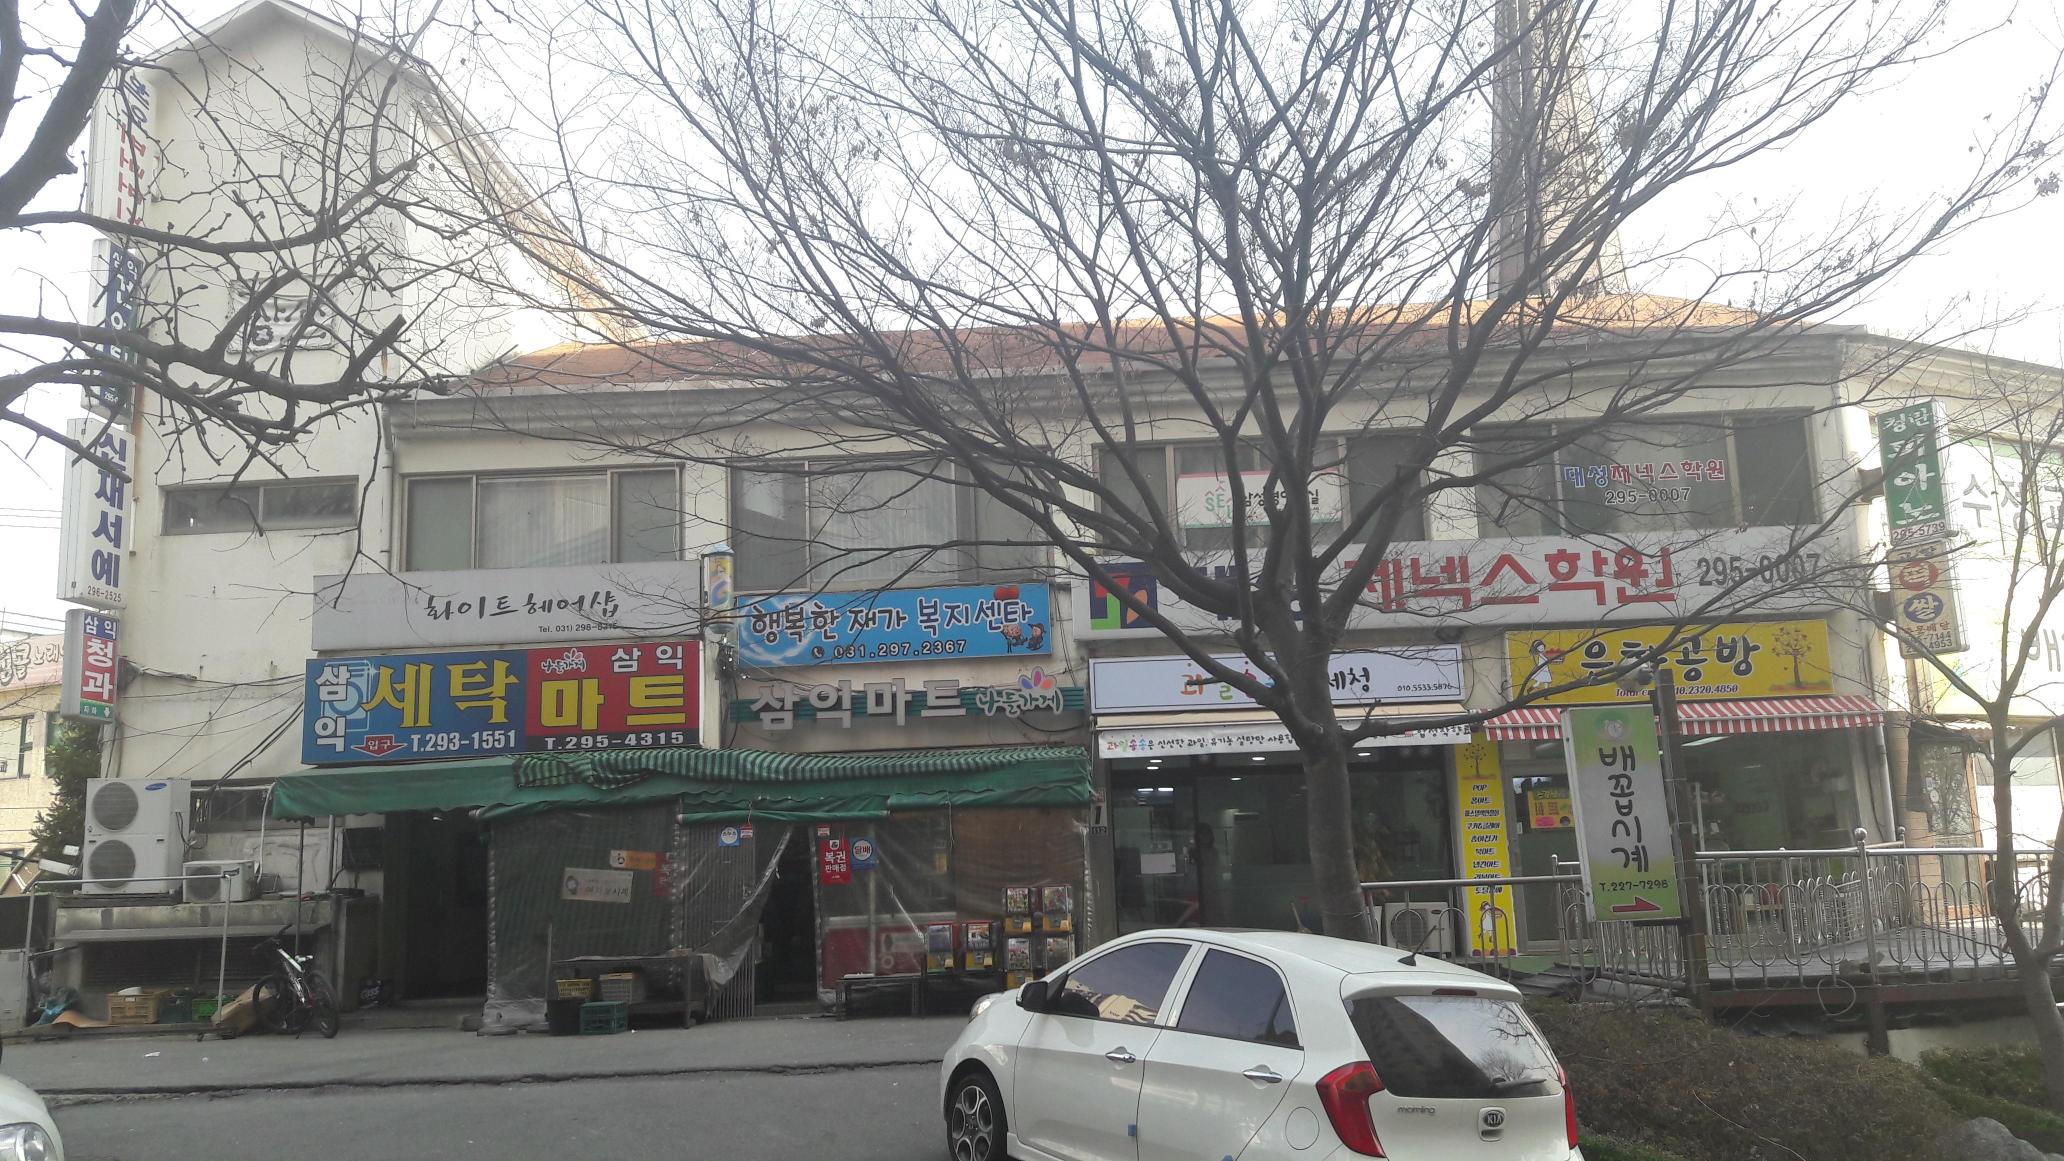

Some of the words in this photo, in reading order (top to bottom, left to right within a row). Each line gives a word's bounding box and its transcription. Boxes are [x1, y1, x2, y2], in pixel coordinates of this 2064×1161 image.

[1604, 488, 1691, 505] 295-0007
[87, 585, 122, 604] 296-2525
[1908, 594, 1939, 620] 쌀
[85, 615, 117, 640] 삼익
[538, 625, 553, 633] Tel.
[556, 623, 573, 633] 031)
[751, 603, 838, 643] 행복한
[848, 606, 907, 634] 재가
[918, 597, 1033, 637] 복지센타
[611, 645, 684, 673] 삼익
[833, 639, 967, 659] 031.297.2367
[82, 638, 114, 700] 청과
[360, 659, 520, 728] 세탁
[541, 674, 686, 730] 마트
[750, 677, 967, 731] 삼익마트
[314, 665, 351, 753] 삼익
[367, 738, 393, 750] 입구
[410, 729, 515, 752] T.293-1551
[544, 731, 684, 750] T.295-4315
[1157, 736, 1184, 749] 신선한
[1599, 745, 1649, 872] 배꼽시계
[825, 850, 846, 863] 복권
[825, 863, 847, 873] 판매점
[1397, 1105, 1437, 1116] morning
[1486, 1111, 1503, 1125] KIA
